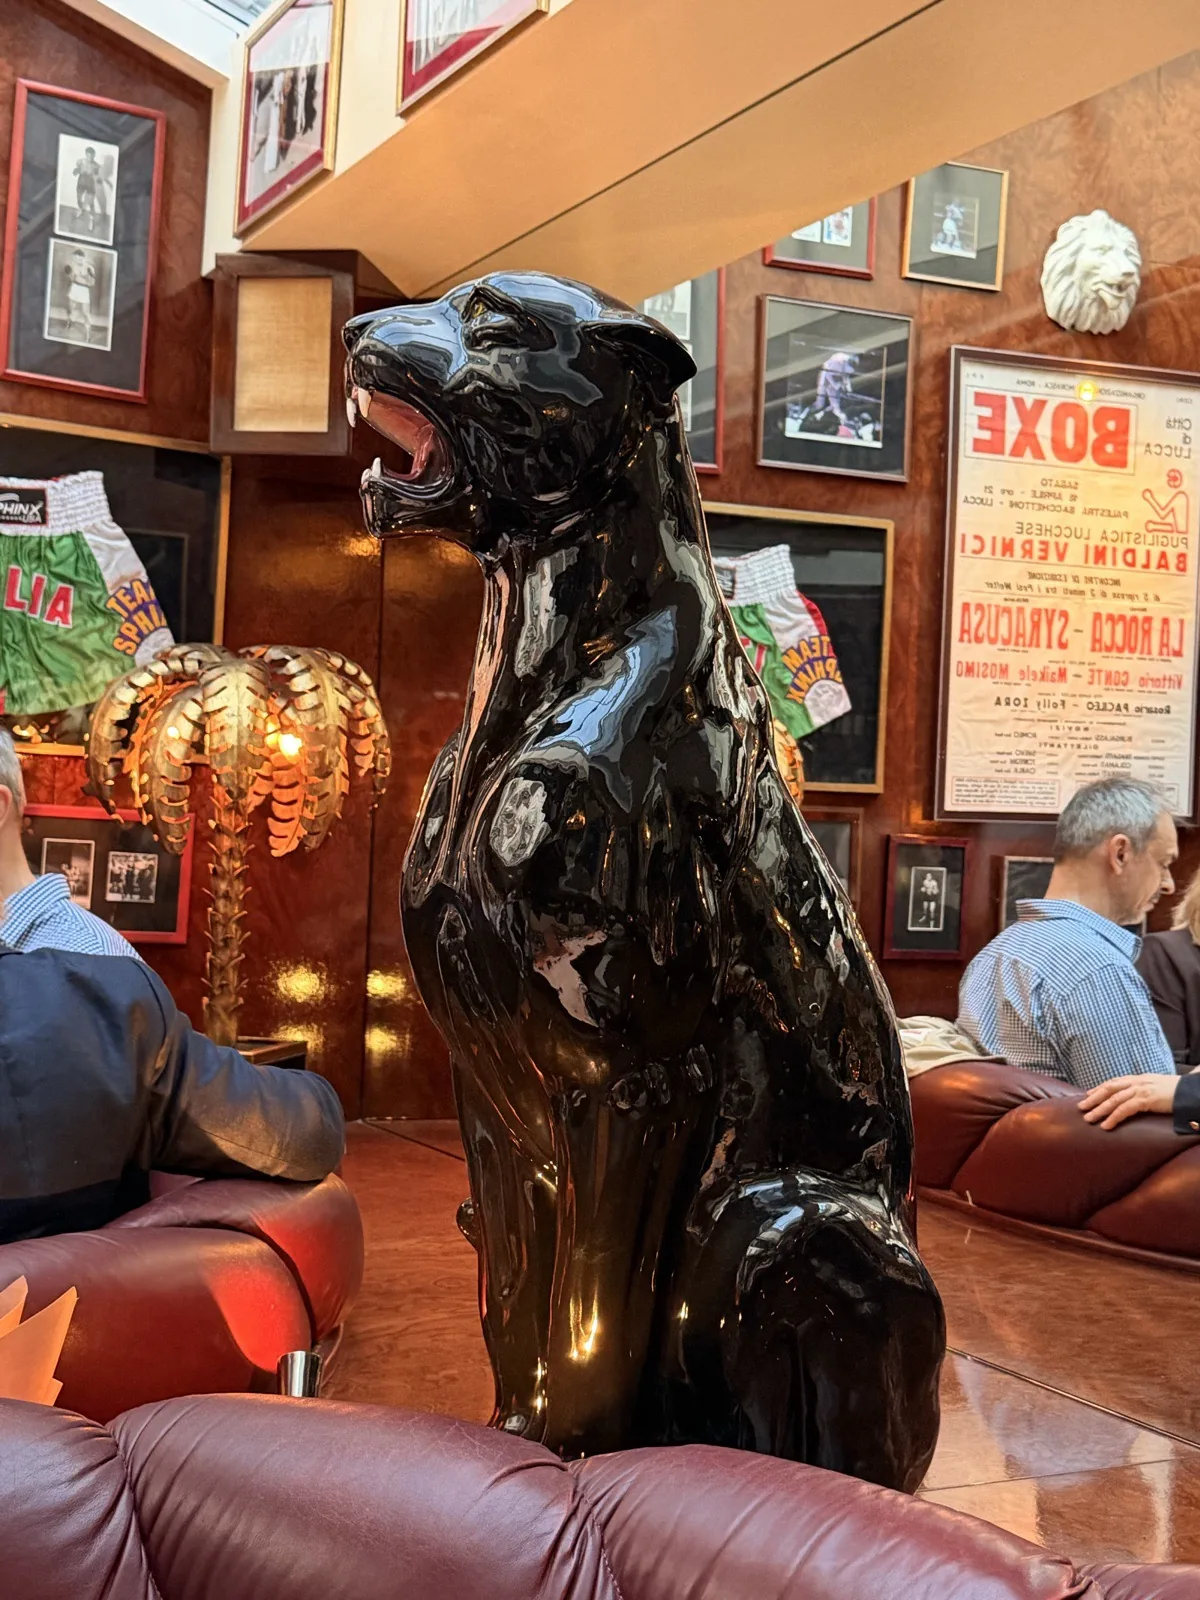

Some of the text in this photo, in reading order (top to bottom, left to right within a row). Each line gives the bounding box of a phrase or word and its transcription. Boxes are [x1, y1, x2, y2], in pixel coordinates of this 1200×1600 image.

[0, 500, 44, 516] PHINX
[4, 565, 75, 629] LIA
[112, 604, 168, 656] SPHI
